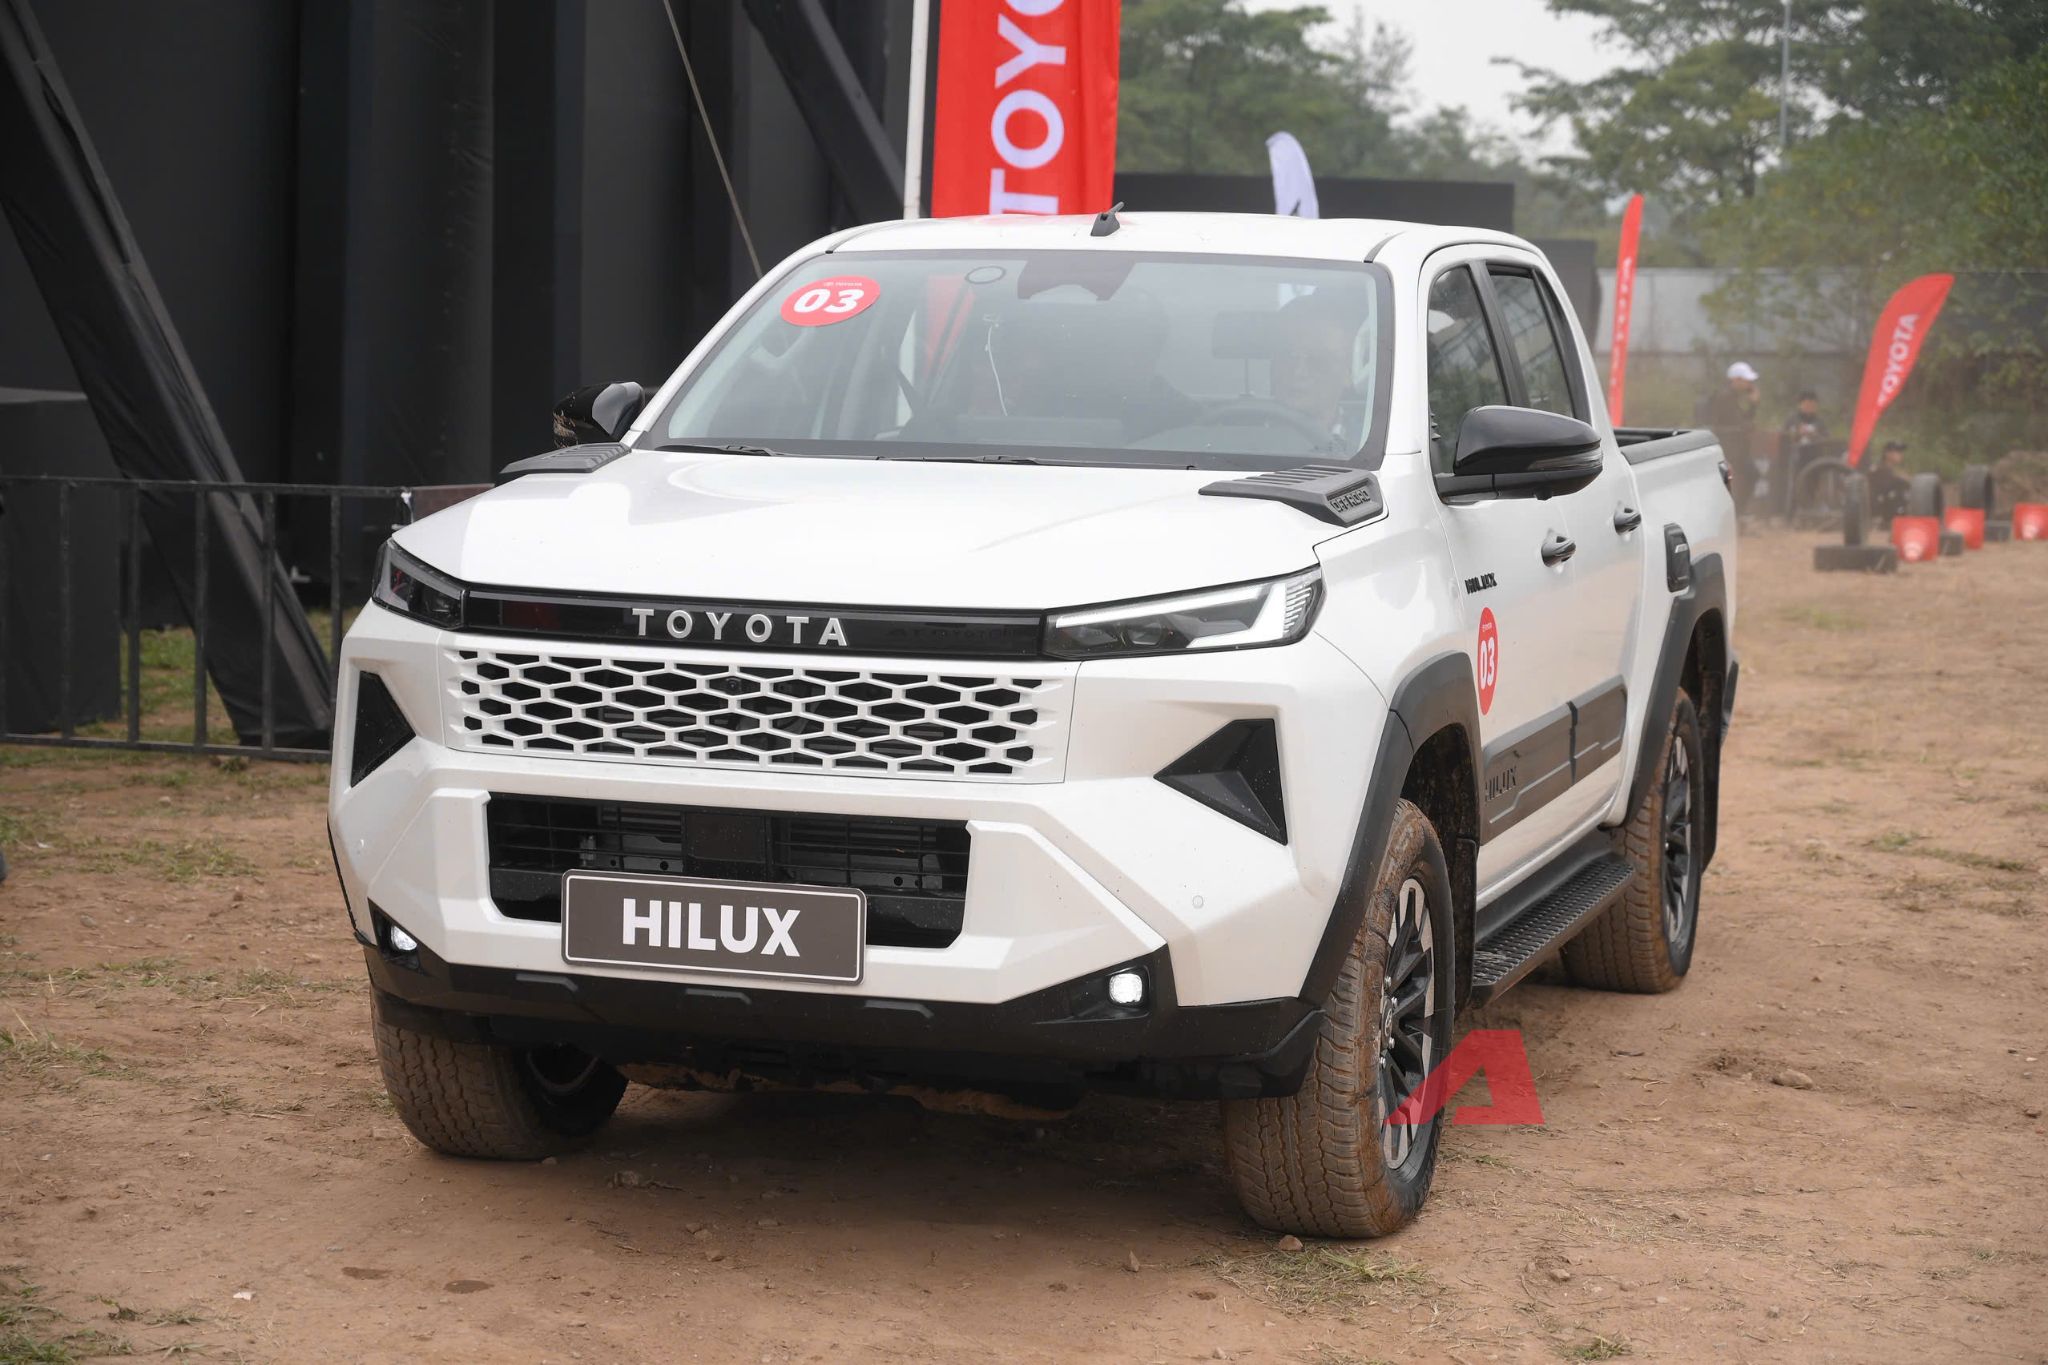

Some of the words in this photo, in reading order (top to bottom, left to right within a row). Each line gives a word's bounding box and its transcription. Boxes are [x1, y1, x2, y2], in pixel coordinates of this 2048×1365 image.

[989, 0, 1066, 215] TOY
[793, 288, 865, 313] 03
[1877, 313, 1920, 408] TOYOTA
[631, 608, 848, 646] TOYOTA
[1480, 636, 1495, 690] 03
[622, 898, 801, 957] HILUX
